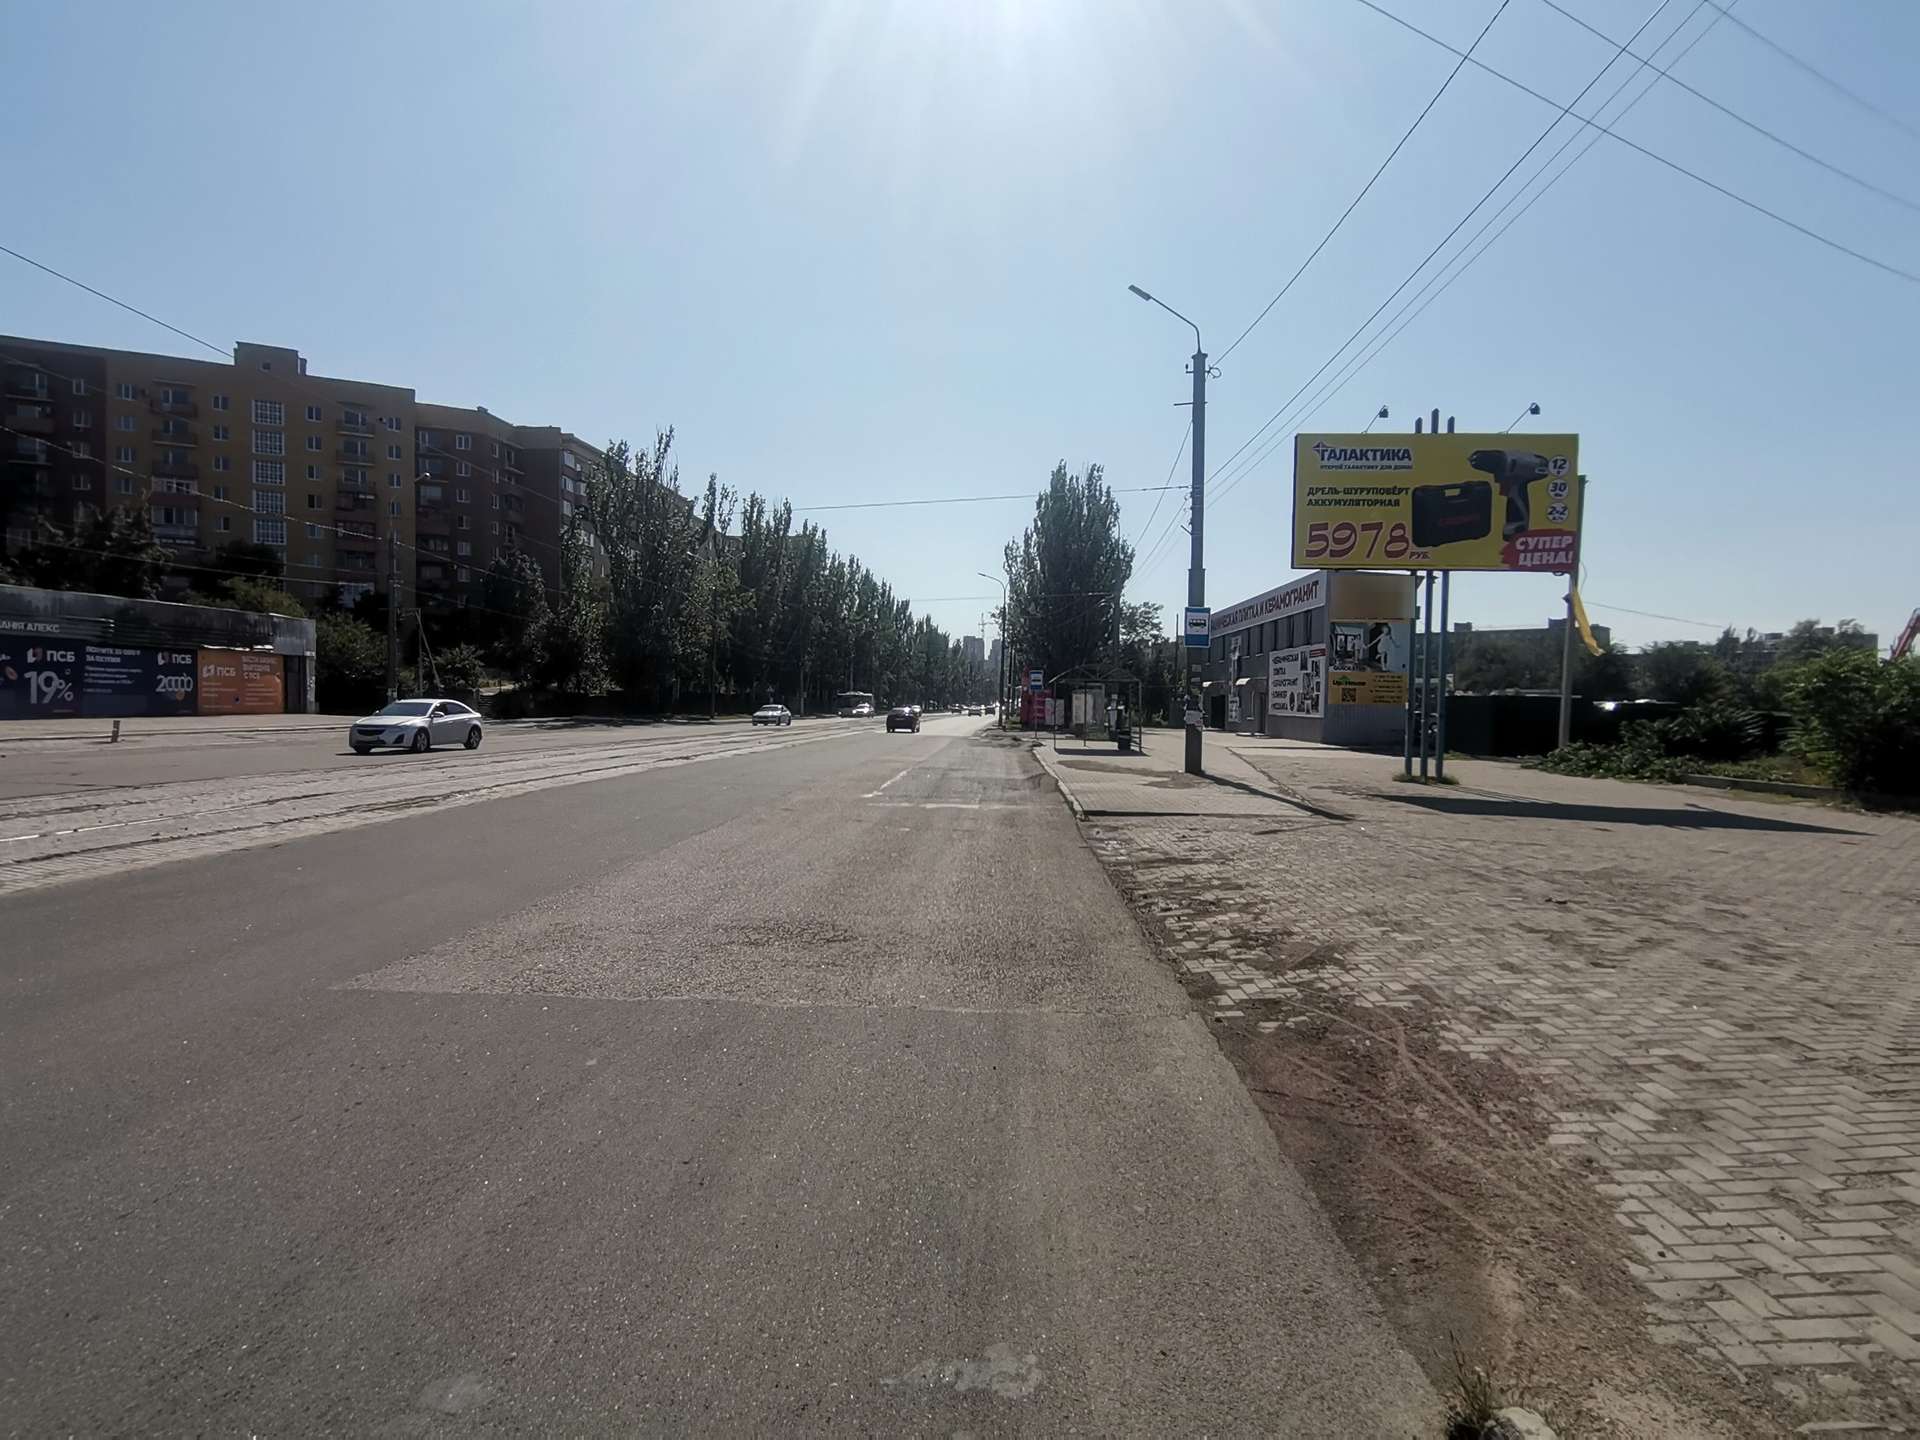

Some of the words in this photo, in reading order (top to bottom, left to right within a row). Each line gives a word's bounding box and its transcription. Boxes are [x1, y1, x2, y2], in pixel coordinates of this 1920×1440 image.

[1320, 448, 1412, 462] ГАЛАКТИКА
[1552, 459, 1567, 470] 12
[1307, 486, 1411, 496] ДРЕЛЬ-ШУРУПОВЁРТ
[1550, 482, 1567, 492] 30
[1307, 498, 1401, 507] АККУМУЛЯТОРНАЯ
[1305, 521, 1410, 559] 5978
[1516, 535, 1573, 550] СУПЕР
[1519, 551, 1574, 566] ЦЕНА!
[1265, 580, 1319, 614] КЕРАМОГРАНИТ
[46, 650, 76, 663] ПСБ
[172, 653, 192, 664] ПСБ
[24, 670, 74, 704] 19%
